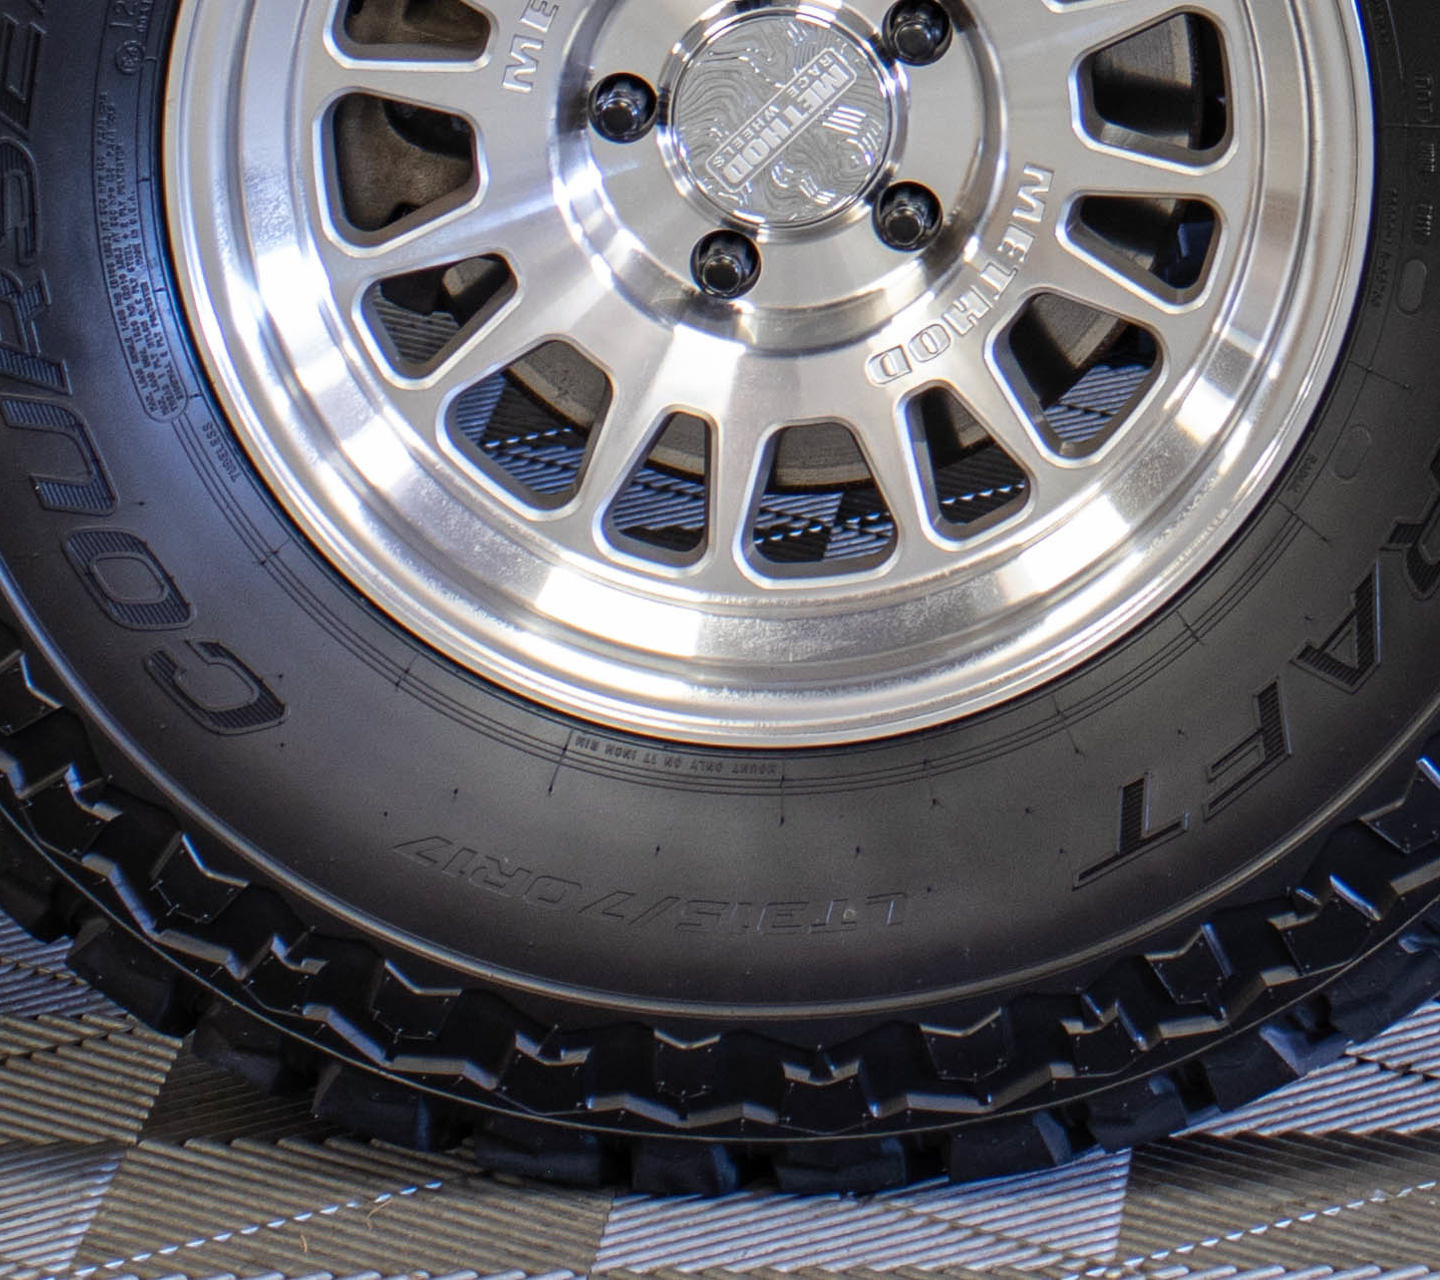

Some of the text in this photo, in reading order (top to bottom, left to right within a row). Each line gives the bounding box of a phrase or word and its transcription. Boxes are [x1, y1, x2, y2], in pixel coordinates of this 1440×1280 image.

[711, 54, 831, 168] RACE WHEELS
[720, 63, 849, 185] METHOD
[866, 163, 1054, 386] METHOD
